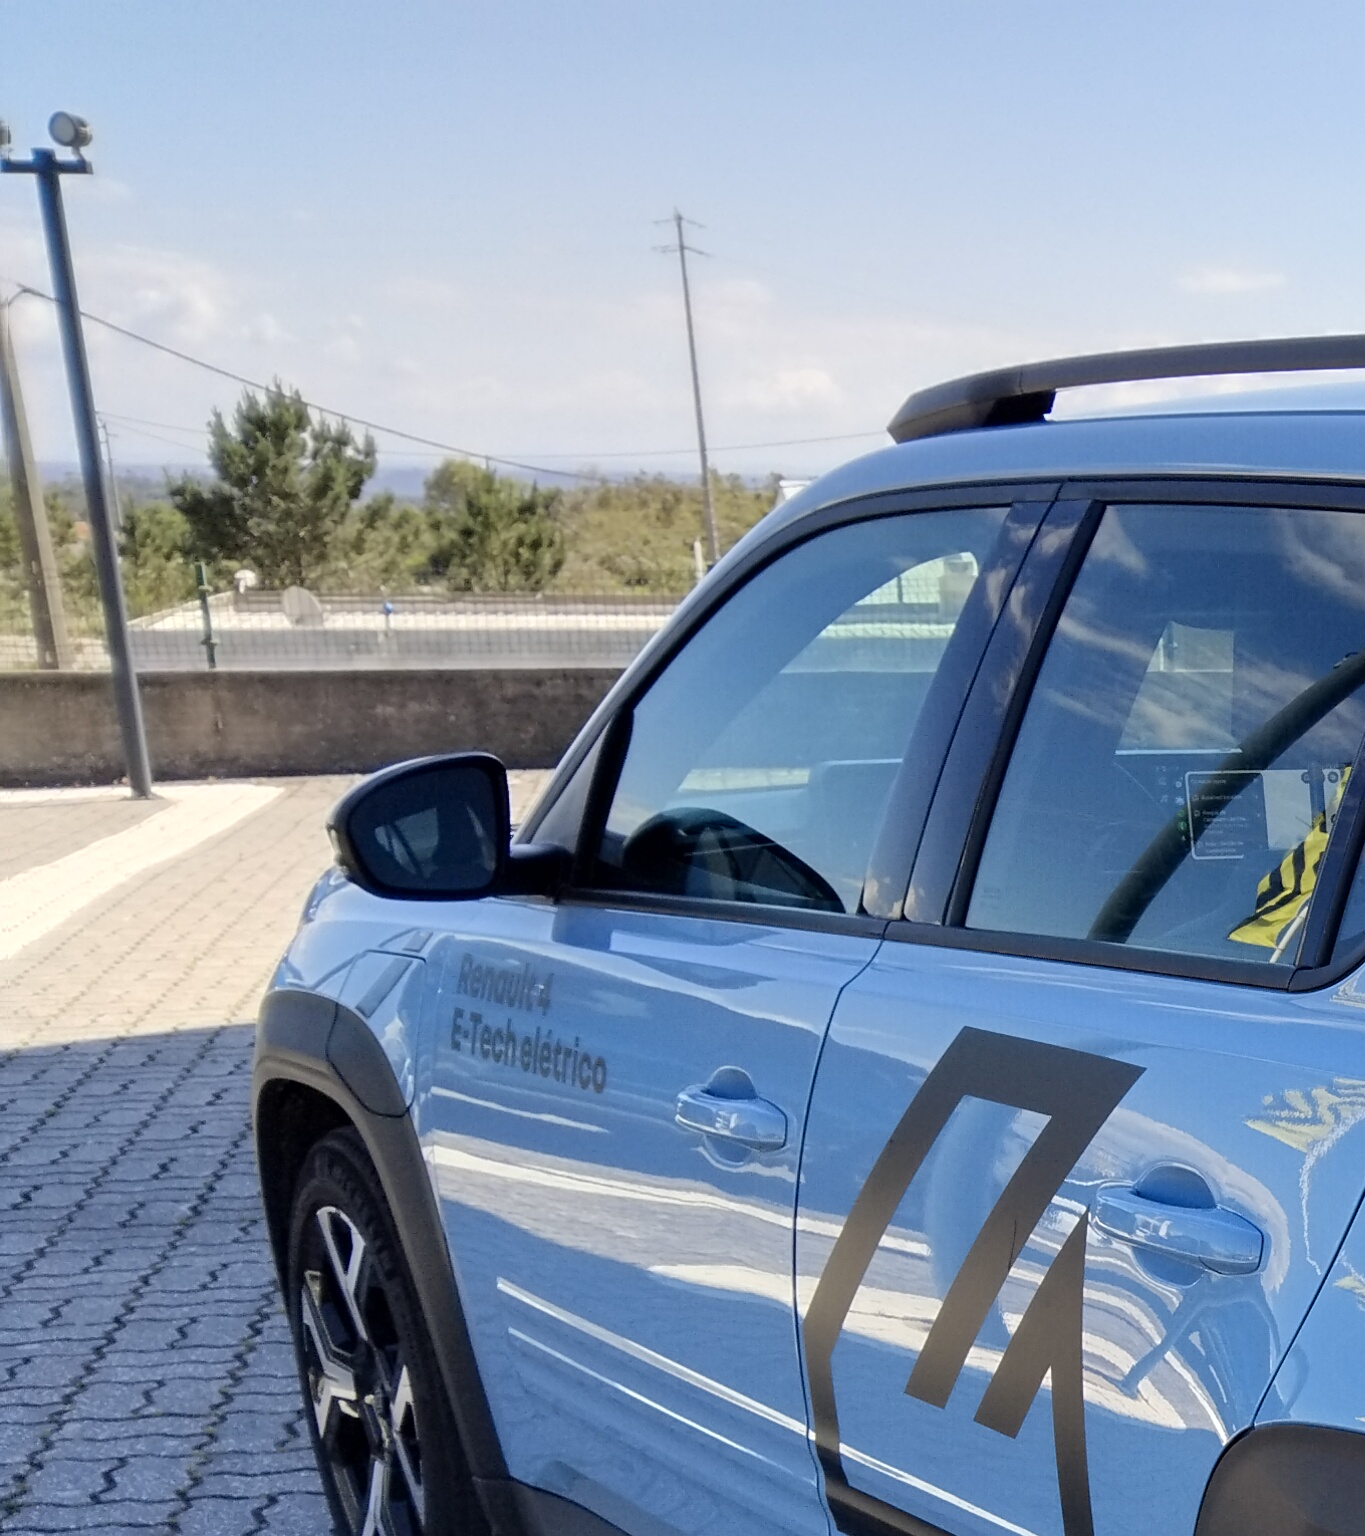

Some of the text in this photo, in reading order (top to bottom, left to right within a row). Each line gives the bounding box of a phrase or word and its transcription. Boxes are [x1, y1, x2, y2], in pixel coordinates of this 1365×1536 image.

[457, 953, 555, 1018] Renault 4
[450, 1006, 608, 1094] E-Tech elétrico
